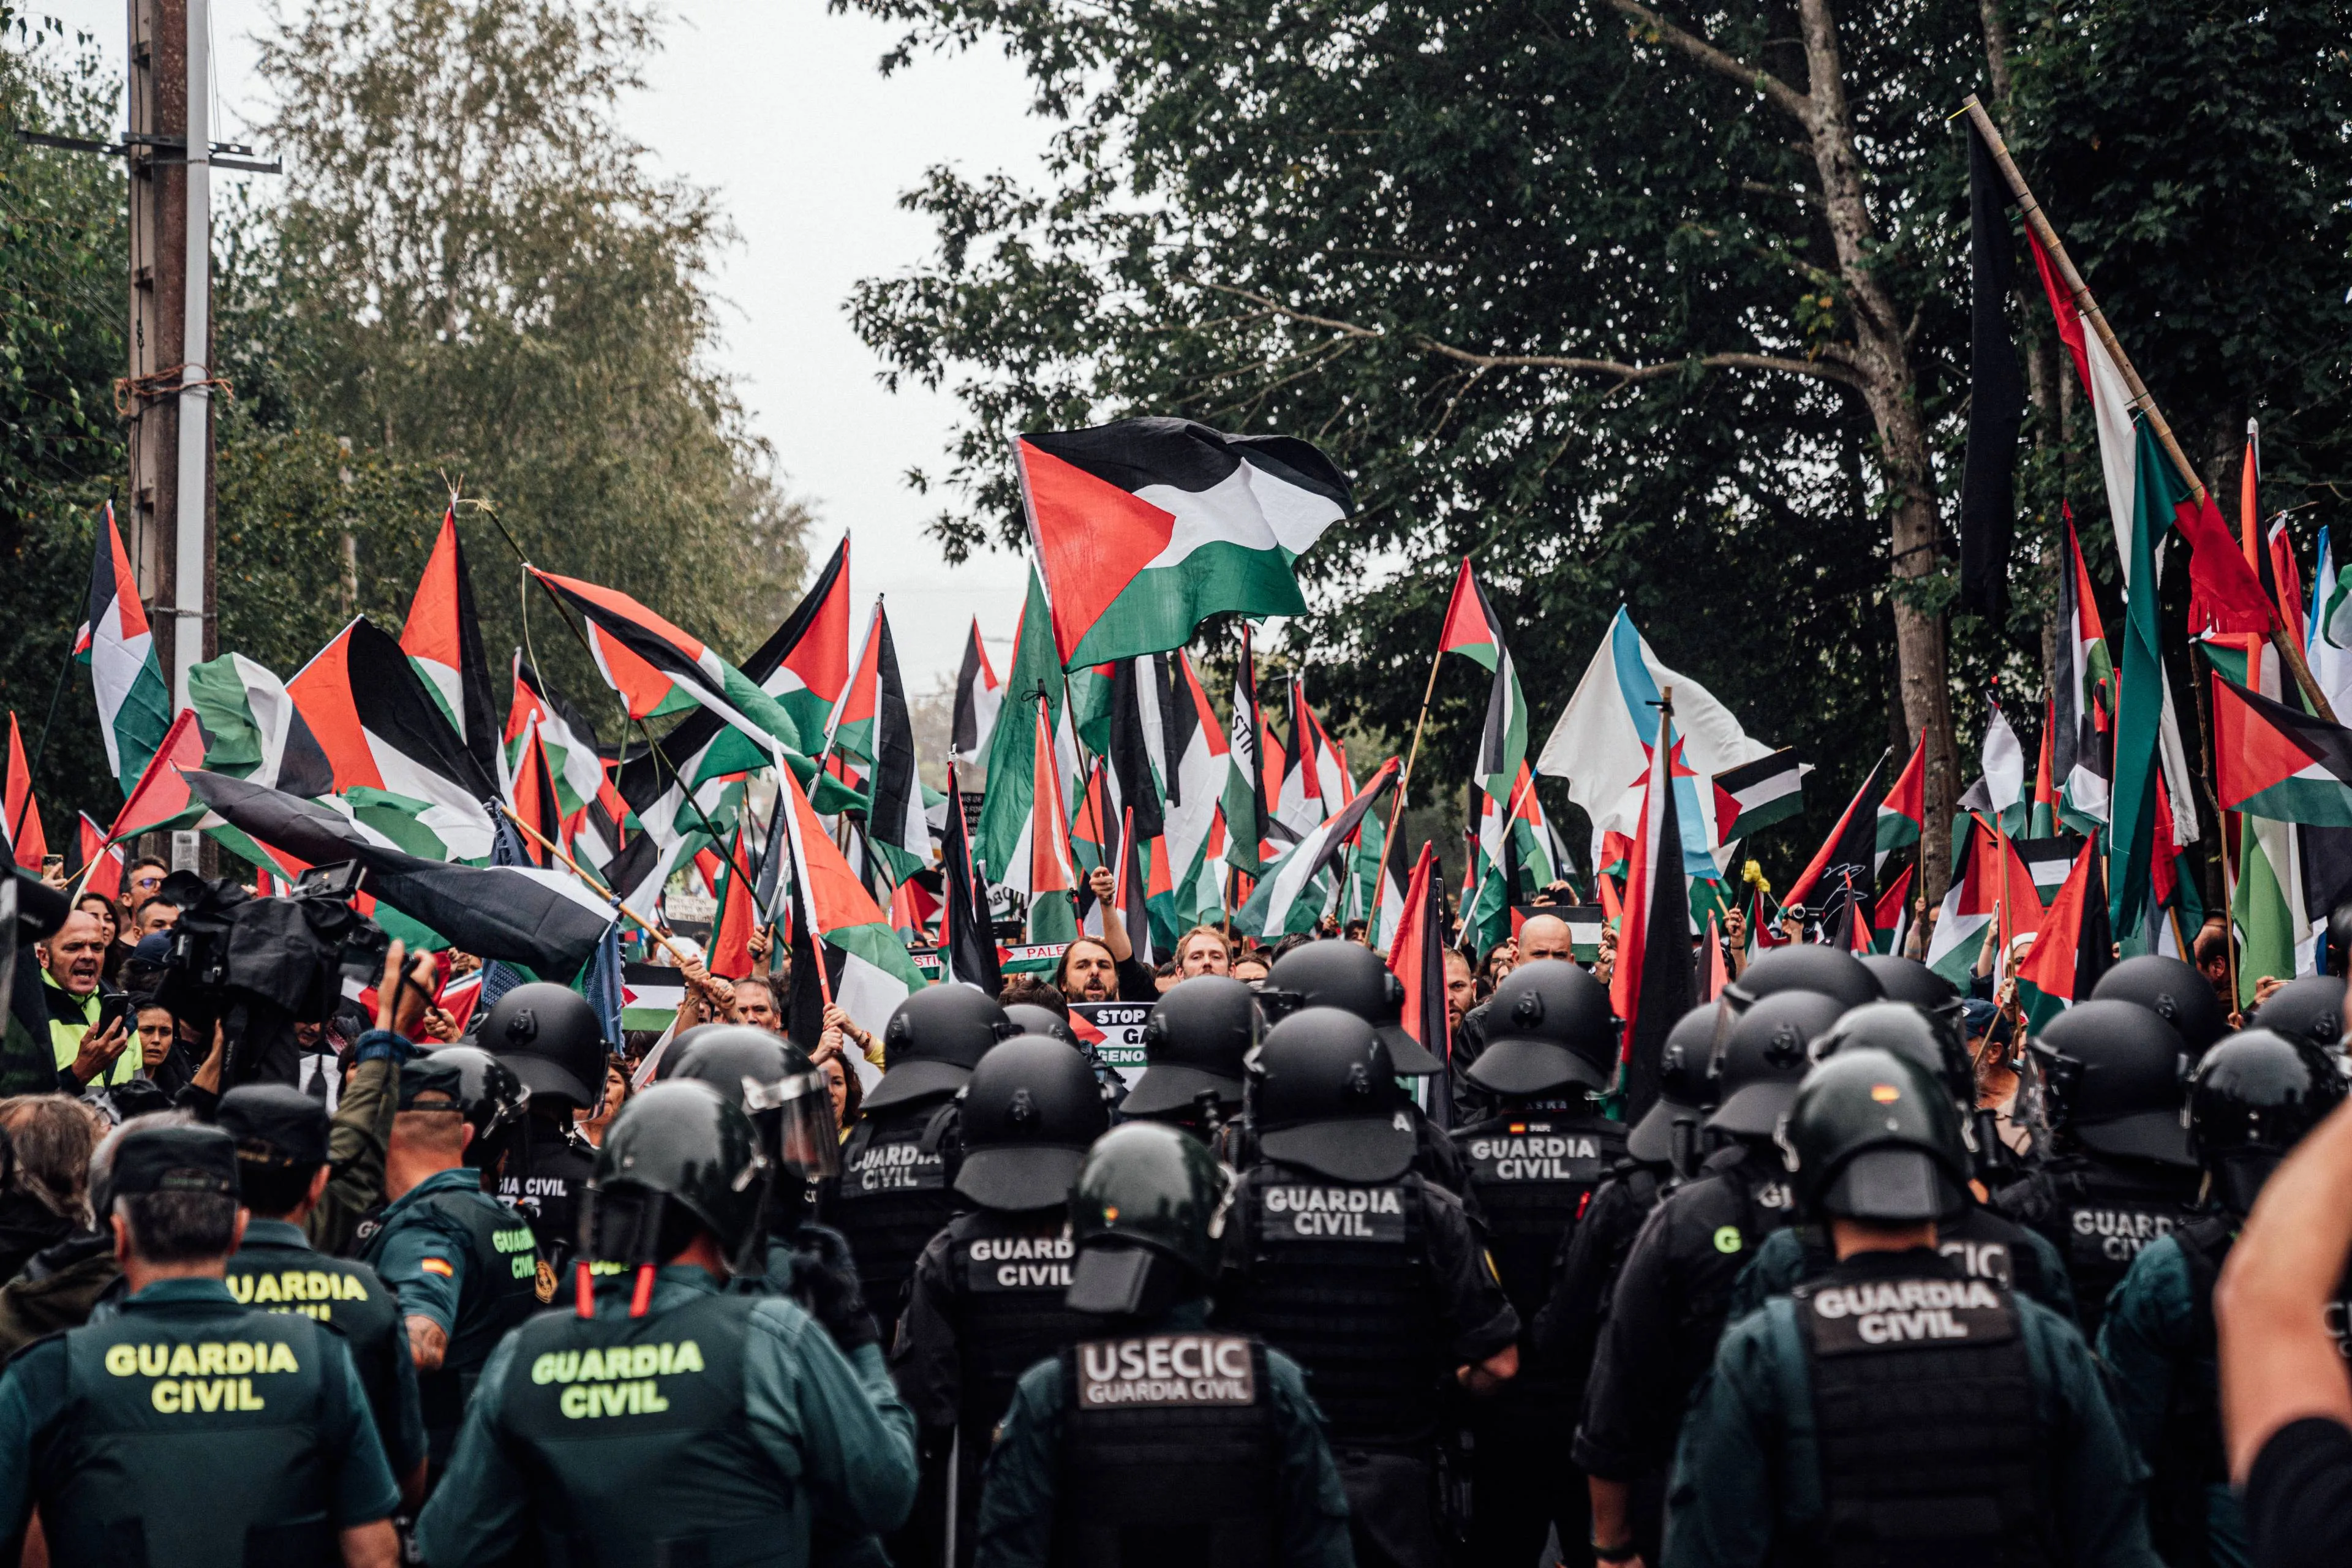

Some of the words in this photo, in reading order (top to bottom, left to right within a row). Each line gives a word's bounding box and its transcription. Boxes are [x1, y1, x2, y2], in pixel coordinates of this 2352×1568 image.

[1232, 701, 1253, 755] STI
[1097, 1009, 1145, 1024] STOP
[1098, 1050, 1147, 1061] GENO
[1471, 1139, 1596, 1159] GUARDIA
[861, 1167, 918, 1189] CIVIL
[1496, 1159, 1570, 1179] CIVIL
[526, 1178, 567, 1197] CIVIL
[1267, 1187, 1400, 1215] GUARDIA
[1295, 1213, 1373, 1237] CIVIL
[512, 1254, 536, 1279] CIVIL
[1815, 1280, 1999, 1319] GUARDIA
[1858, 1311, 1968, 1343] CIVIL
[105, 1342, 300, 1377] GUARDIA
[532, 1340, 704, 1385] GUARDIA
[1085, 1340, 1246, 1381] USECIC
[152, 1378, 265, 1413] CIVIL
[560, 1381, 669, 1419] CIVIL
[1087, 1380, 1188, 1403] GUARDIA
[1192, 1379, 1248, 1400] CIVIL
